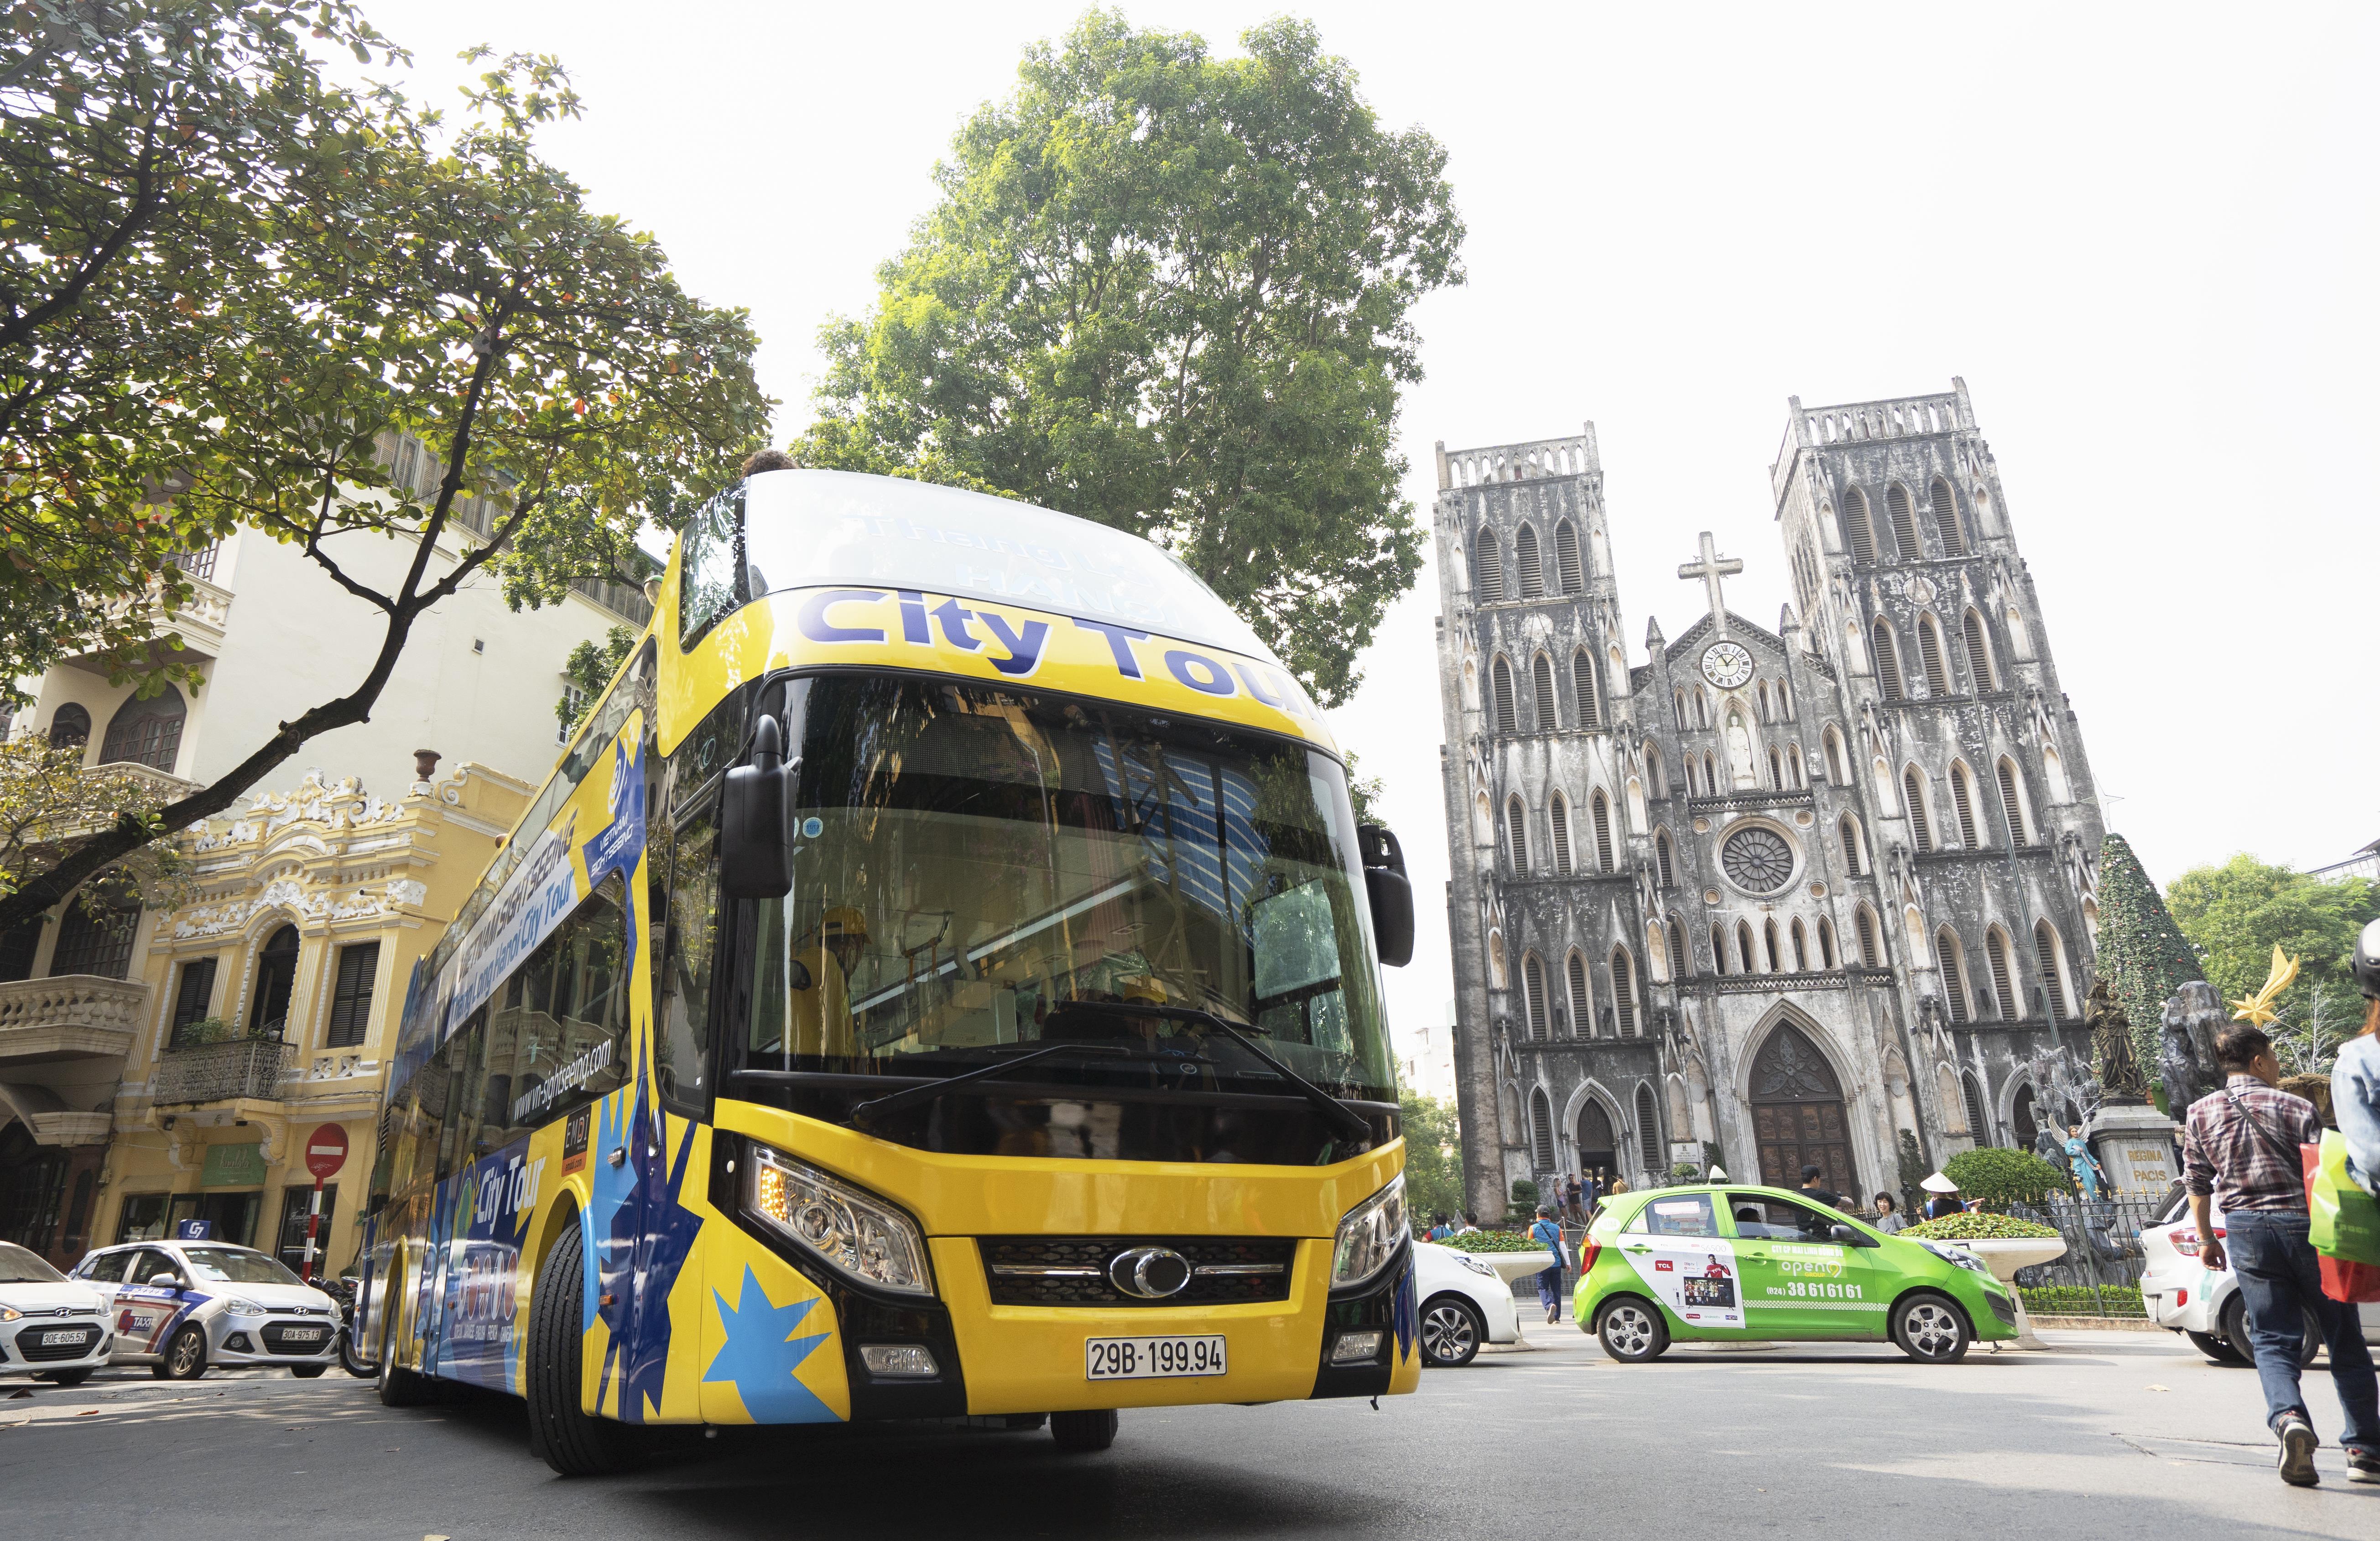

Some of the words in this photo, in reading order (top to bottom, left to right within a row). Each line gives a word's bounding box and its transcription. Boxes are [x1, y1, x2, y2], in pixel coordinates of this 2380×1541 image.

[840, 514, 1073, 572] Thang
[797, 590, 1053, 678] City
[600, 811, 629, 851] VIETNAM
[591, 823, 633, 877] SIGHTSEEING
[458, 919, 499, 983] VIETNAM
[496, 807, 579, 938] SIGHTSEEING
[450, 983, 473, 1027] Thang
[472, 960, 494, 1004] Long
[493, 919, 523, 981] Hanoi
[521, 902, 543, 948] City
[544, 867, 575, 926] Tour
[2127, 1150, 2164, 1161] REGINA
[2133, 1170, 2166, 1182] PACIS
[478, 1166, 505, 1235] City
[505, 1155, 546, 1215] Tour
[189, 1222, 204, 1238] G7
[1772, 1245, 1782, 1253] CTY
[1783, 1245, 1791, 1254] CP
[1792, 1246, 1803, 1254] MAI
[1766, 1286, 1786, 1296] (024)
[1787, 1282, 1806, 1296] 38
[1808, 1282, 1824, 1297] 61
[1827, 1283, 1843, 1298] 61
[1845, 1284, 1862, 1299] 61
[134, 1317, 153, 1328] TAXI
[44, 1332, 85, 1343] 30E-605.52
[283, 1330, 319, 1339] 30A-975.13
[487, 1324, 498, 1340] FRENCH
[1092, 1340, 1222, 1374] 29B-199.94
